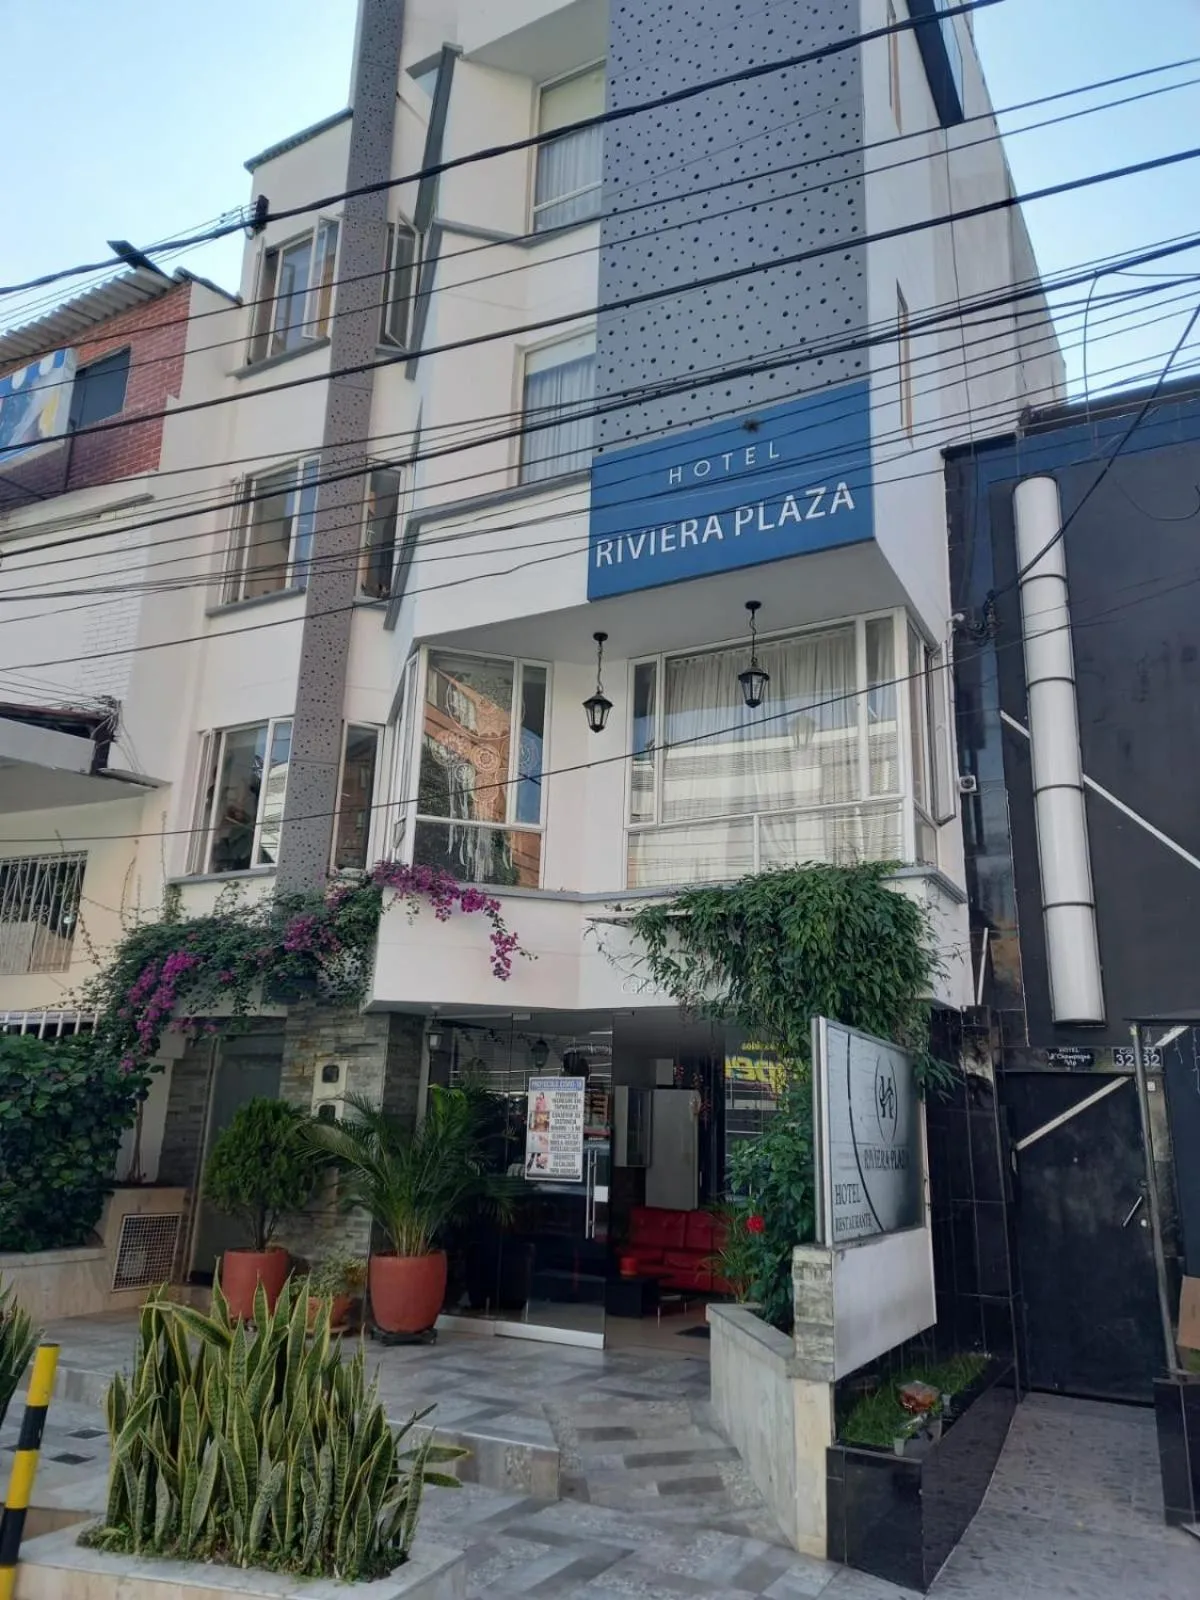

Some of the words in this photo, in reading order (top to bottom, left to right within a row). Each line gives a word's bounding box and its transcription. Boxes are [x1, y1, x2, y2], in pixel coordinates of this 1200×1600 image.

[669, 440, 780, 485] HOTEL
[596, 514, 724, 568] RIVIERA
[734, 481, 856, 537] PLAZA
[834, 1183, 862, 1206] HOTEL
[835, 1212, 874, 1234] RESTAURANTE
